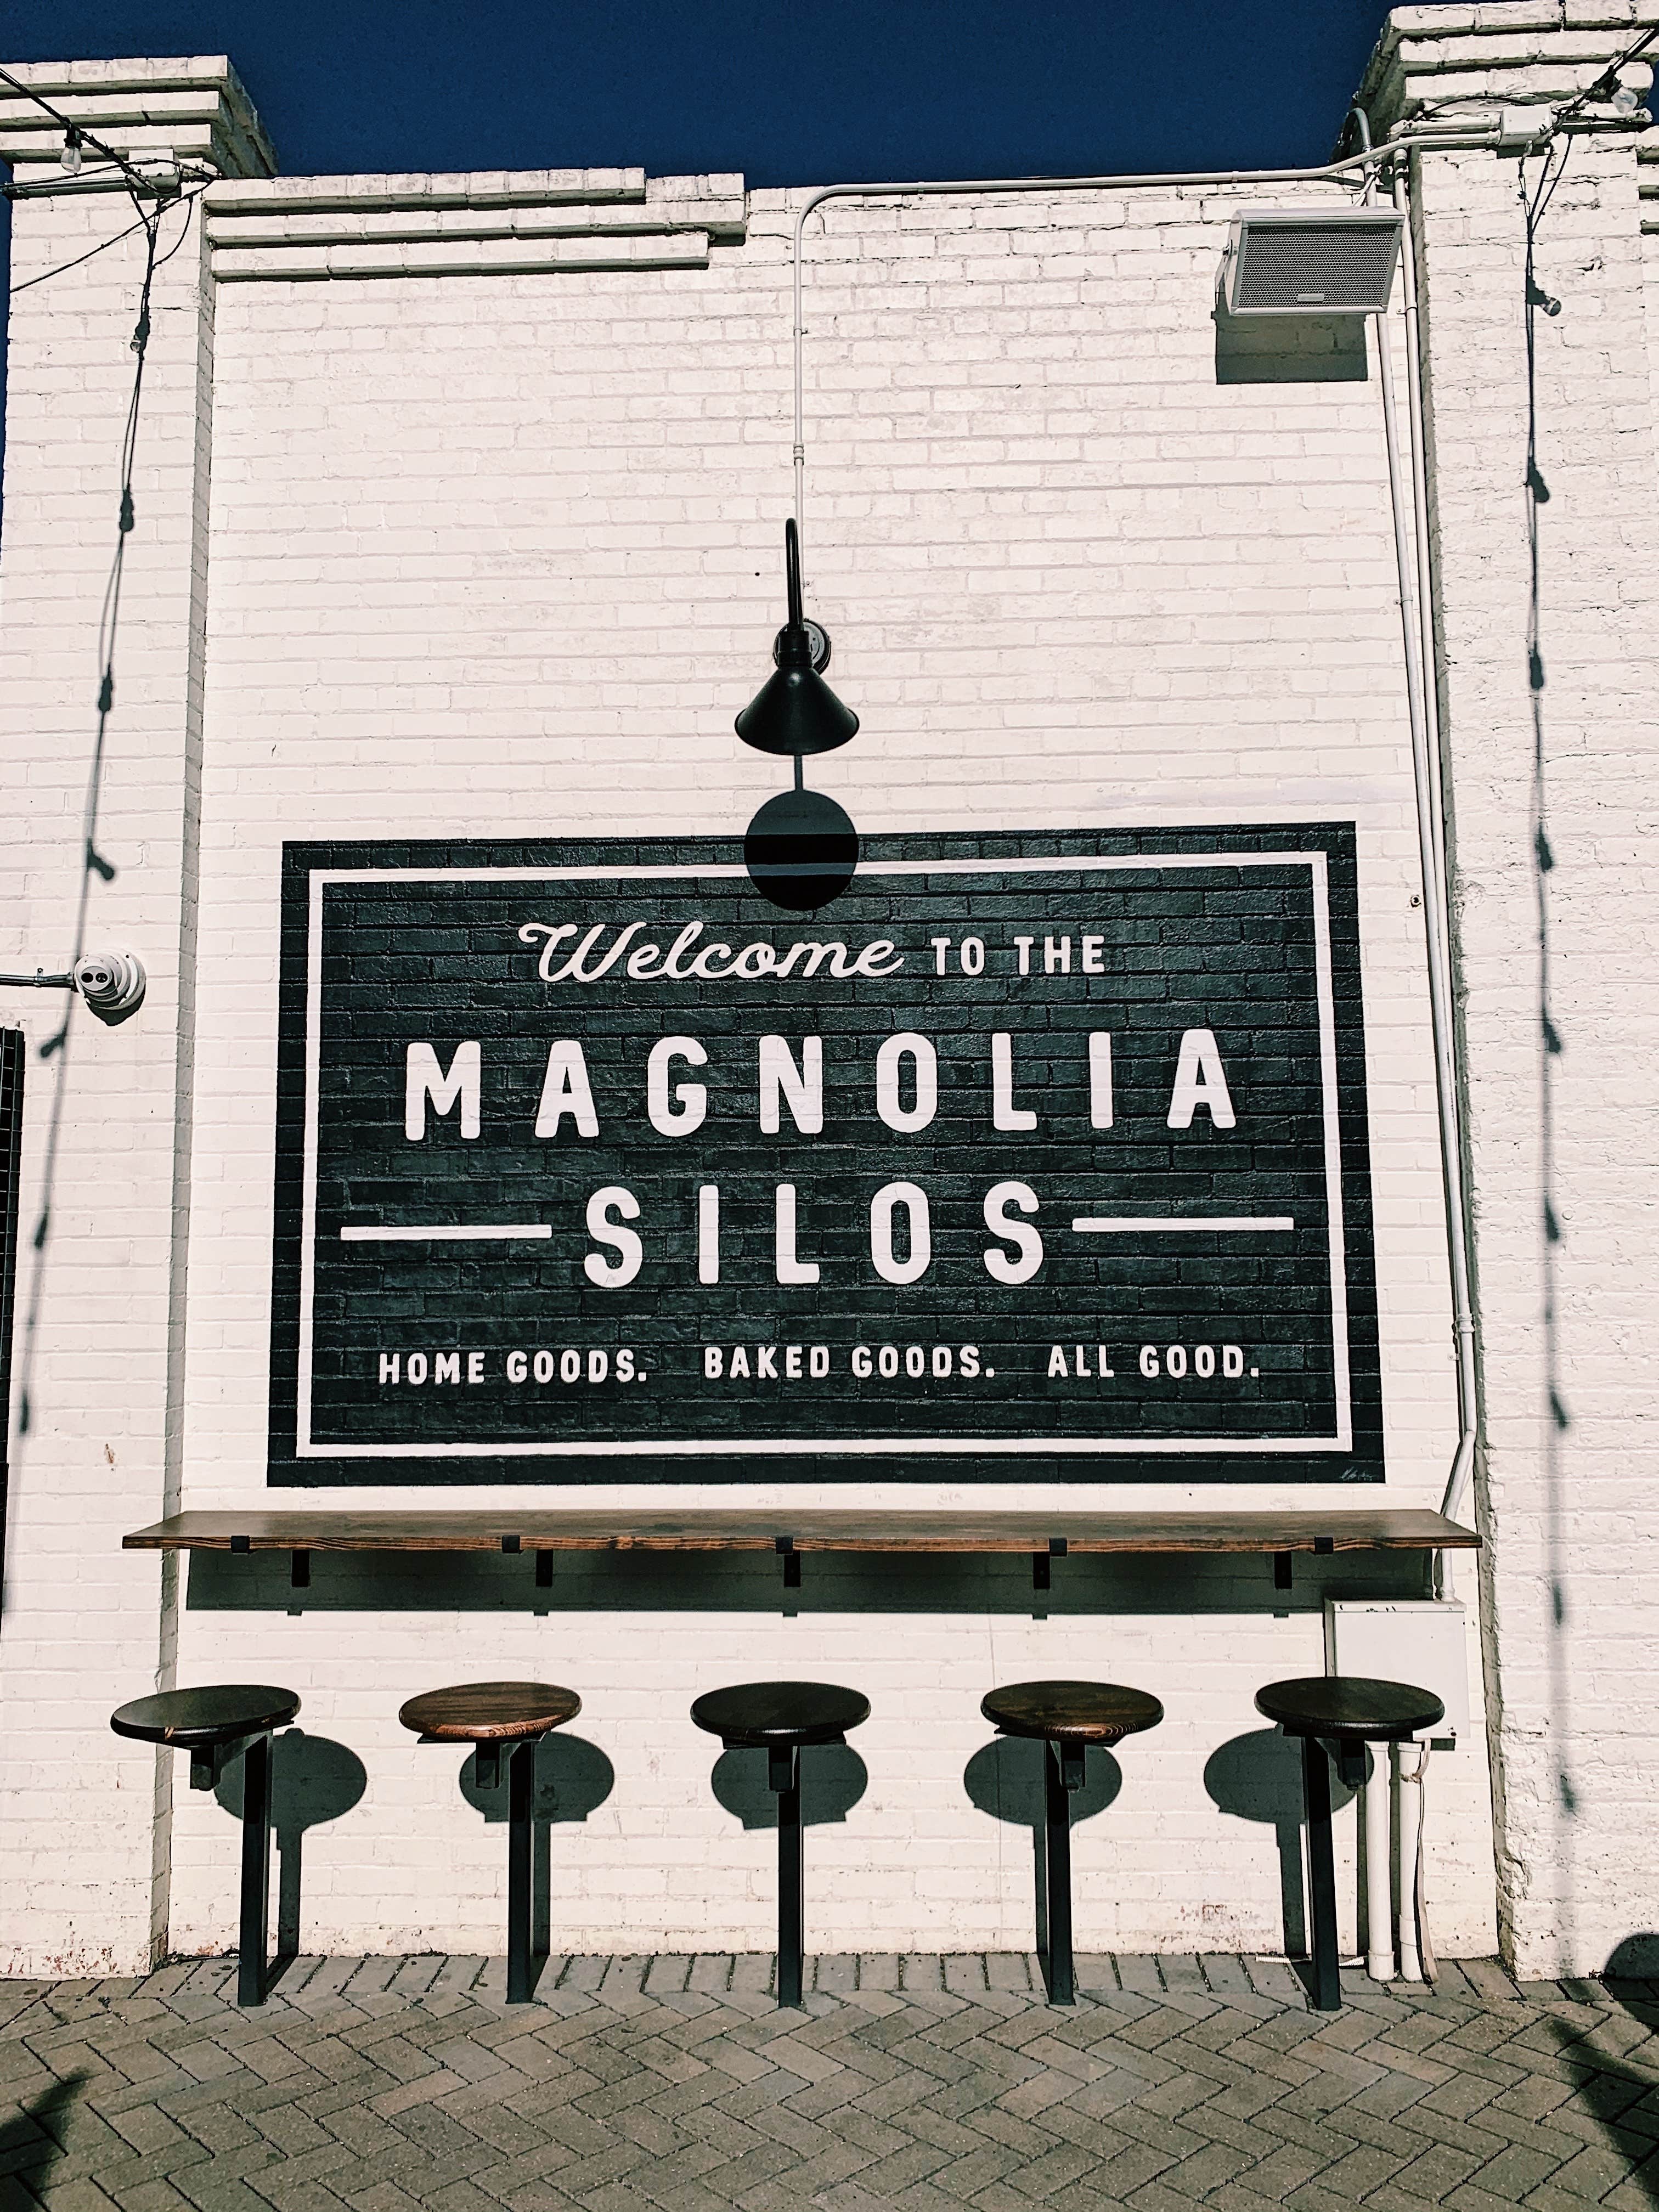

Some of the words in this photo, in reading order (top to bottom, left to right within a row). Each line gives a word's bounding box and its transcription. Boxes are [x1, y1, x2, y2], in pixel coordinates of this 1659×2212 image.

[517, 919, 906, 983] Welcome
[930, 936, 985, 976] TO
[1013, 934, 1105, 976] THE
[404, 1028, 1237, 1142] MAGNOLIA
[583, 1180, 1044, 1289] SILOS
[379, 1351, 486, 1385] HOME
[506, 1348, 647, 1384] GOODS.
[704, 1345, 830, 1379] BAKED
[851, 1344, 995, 1378] GOODS.
[1047, 1344, 1115, 1378] ALL
[1139, 1344, 1260, 1379] GOOD.
